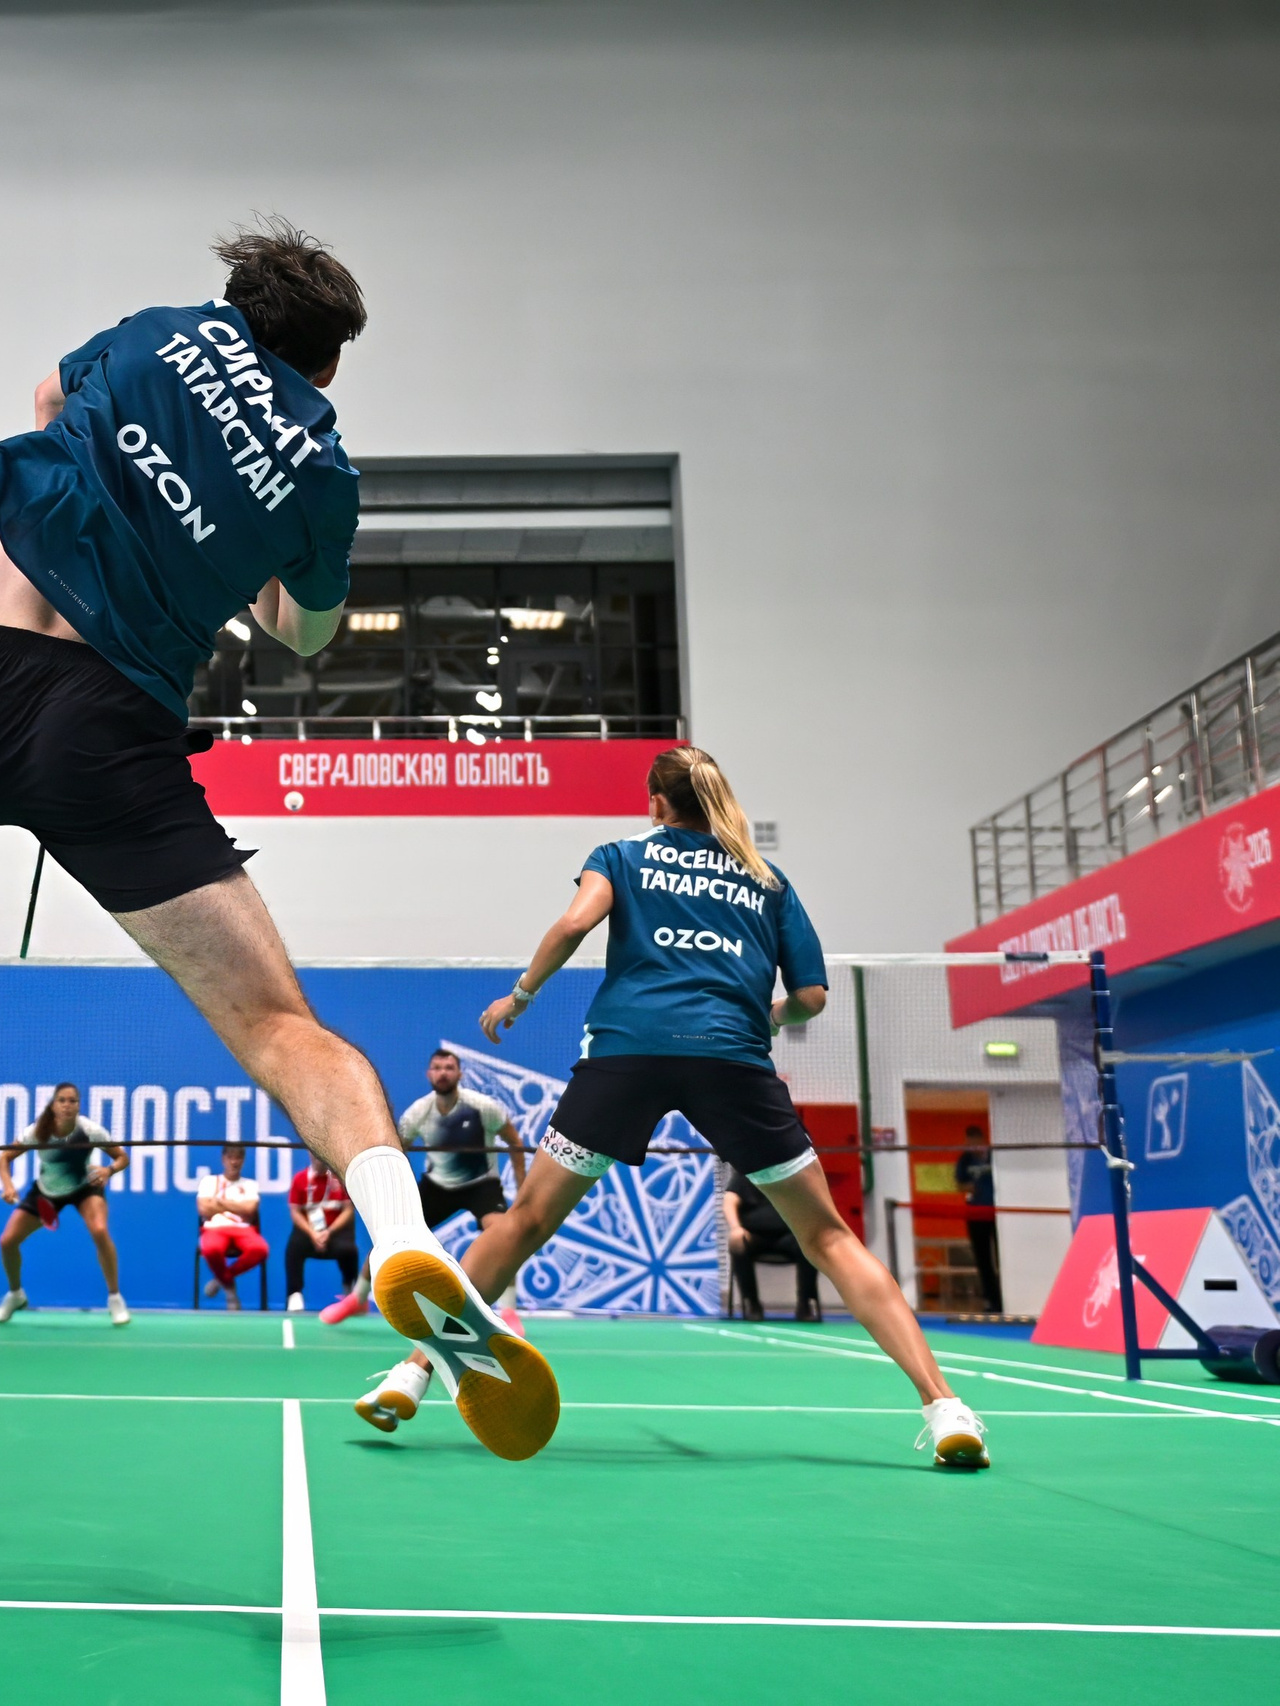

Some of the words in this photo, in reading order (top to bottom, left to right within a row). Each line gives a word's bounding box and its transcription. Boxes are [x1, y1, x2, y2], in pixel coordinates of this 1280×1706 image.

[155, 332, 295, 512] ТАТАРСТАН
[117, 424, 216, 544] OZON
[279, 753, 447, 786] СВЕРДЛОВСКАЯ
[455, 752, 549, 786] ОБЛАСТЬ
[644, 842, 766, 889] КОСЕЦК
[640, 868, 765, 915] ТАТАРСТАН
[654, 926, 742, 957] OZON
